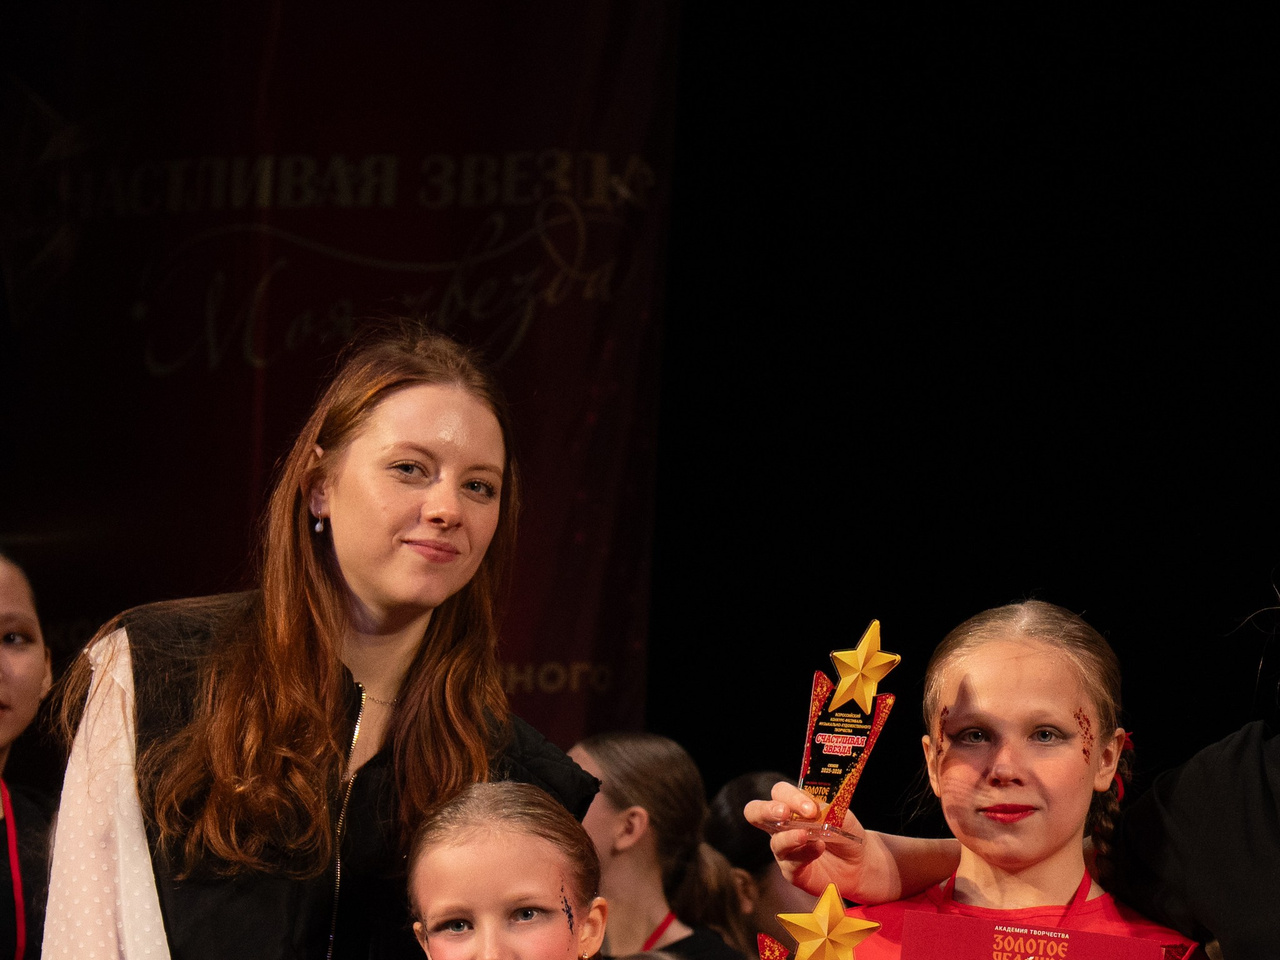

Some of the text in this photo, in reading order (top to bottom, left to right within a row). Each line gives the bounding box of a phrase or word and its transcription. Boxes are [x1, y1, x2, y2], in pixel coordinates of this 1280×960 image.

[816, 733, 866, 746] СЧАСТЛИВАЯ
[823, 745, 852, 756] ЗВЕЗДА
[994, 925, 1069, 938] АКАДЕМИЯ ТВОРЧЕСТВА
[992, 934, 1068, 957] ЗОЛОТОЕ
